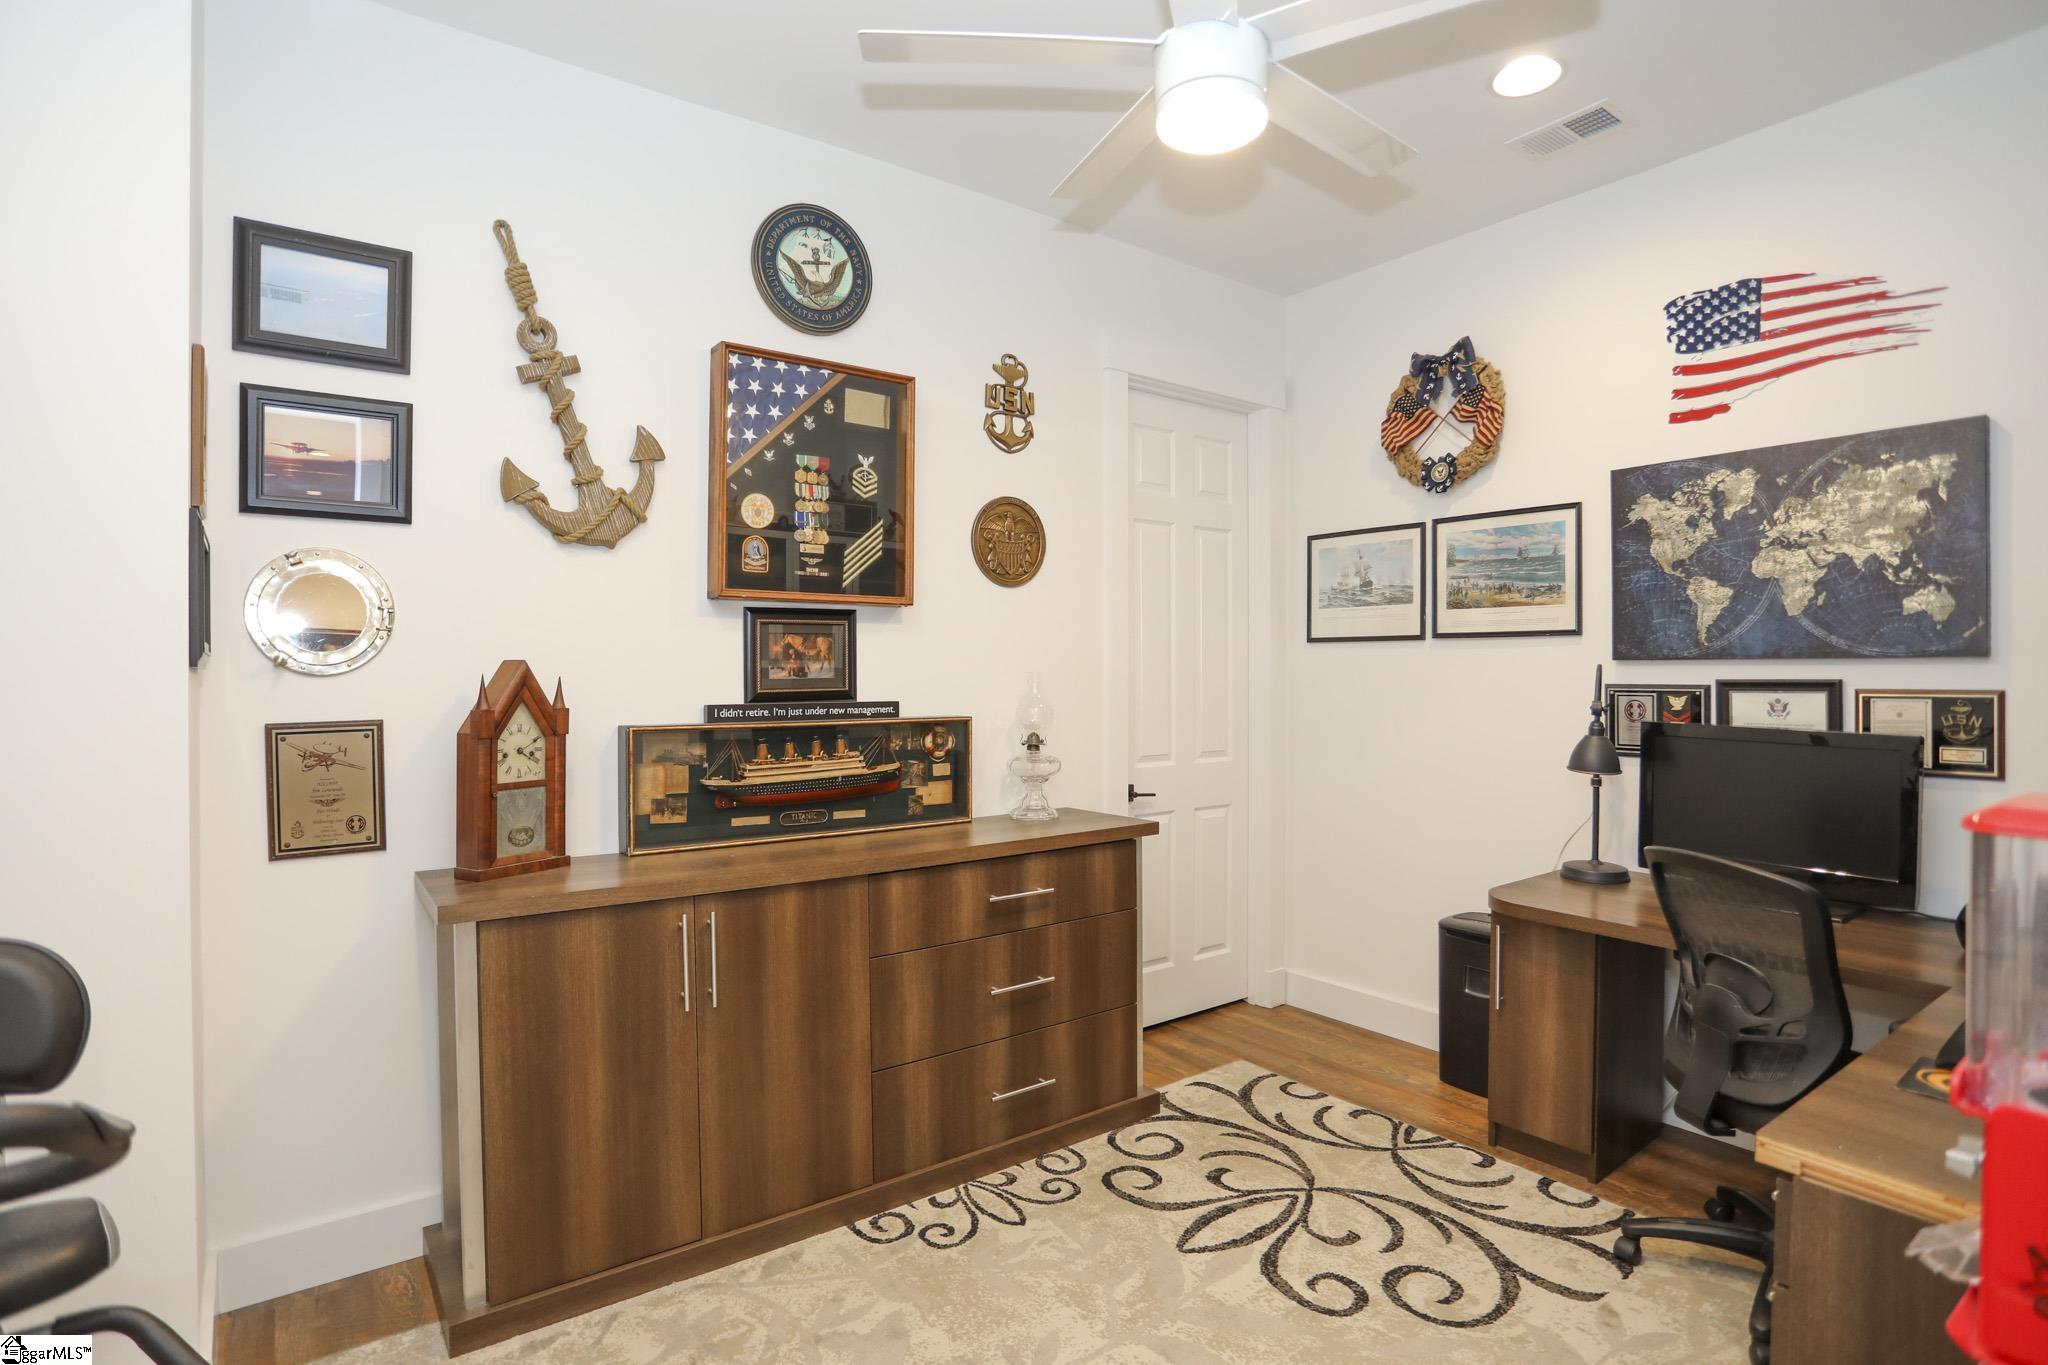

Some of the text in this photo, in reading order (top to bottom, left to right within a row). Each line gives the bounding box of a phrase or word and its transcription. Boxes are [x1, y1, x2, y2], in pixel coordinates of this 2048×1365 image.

[767, 214, 815, 250] DEPARTMENT
[820, 219, 833, 228] OF
[834, 228, 851, 246] THE
[765, 261, 863, 322] UNITED STATES OF AMERICA
[984, 383, 1035, 416] USN
[714, 708, 718, 718] I
[719, 708, 744, 718] didn't
[745, 708, 771, 717] retire.
[773, 707, 786, 717] I'm
[788, 707, 804, 718] just
[804, 706, 828, 716] under
[847, 706, 896, 717] management.
[1941, 714, 1983, 728] USN
